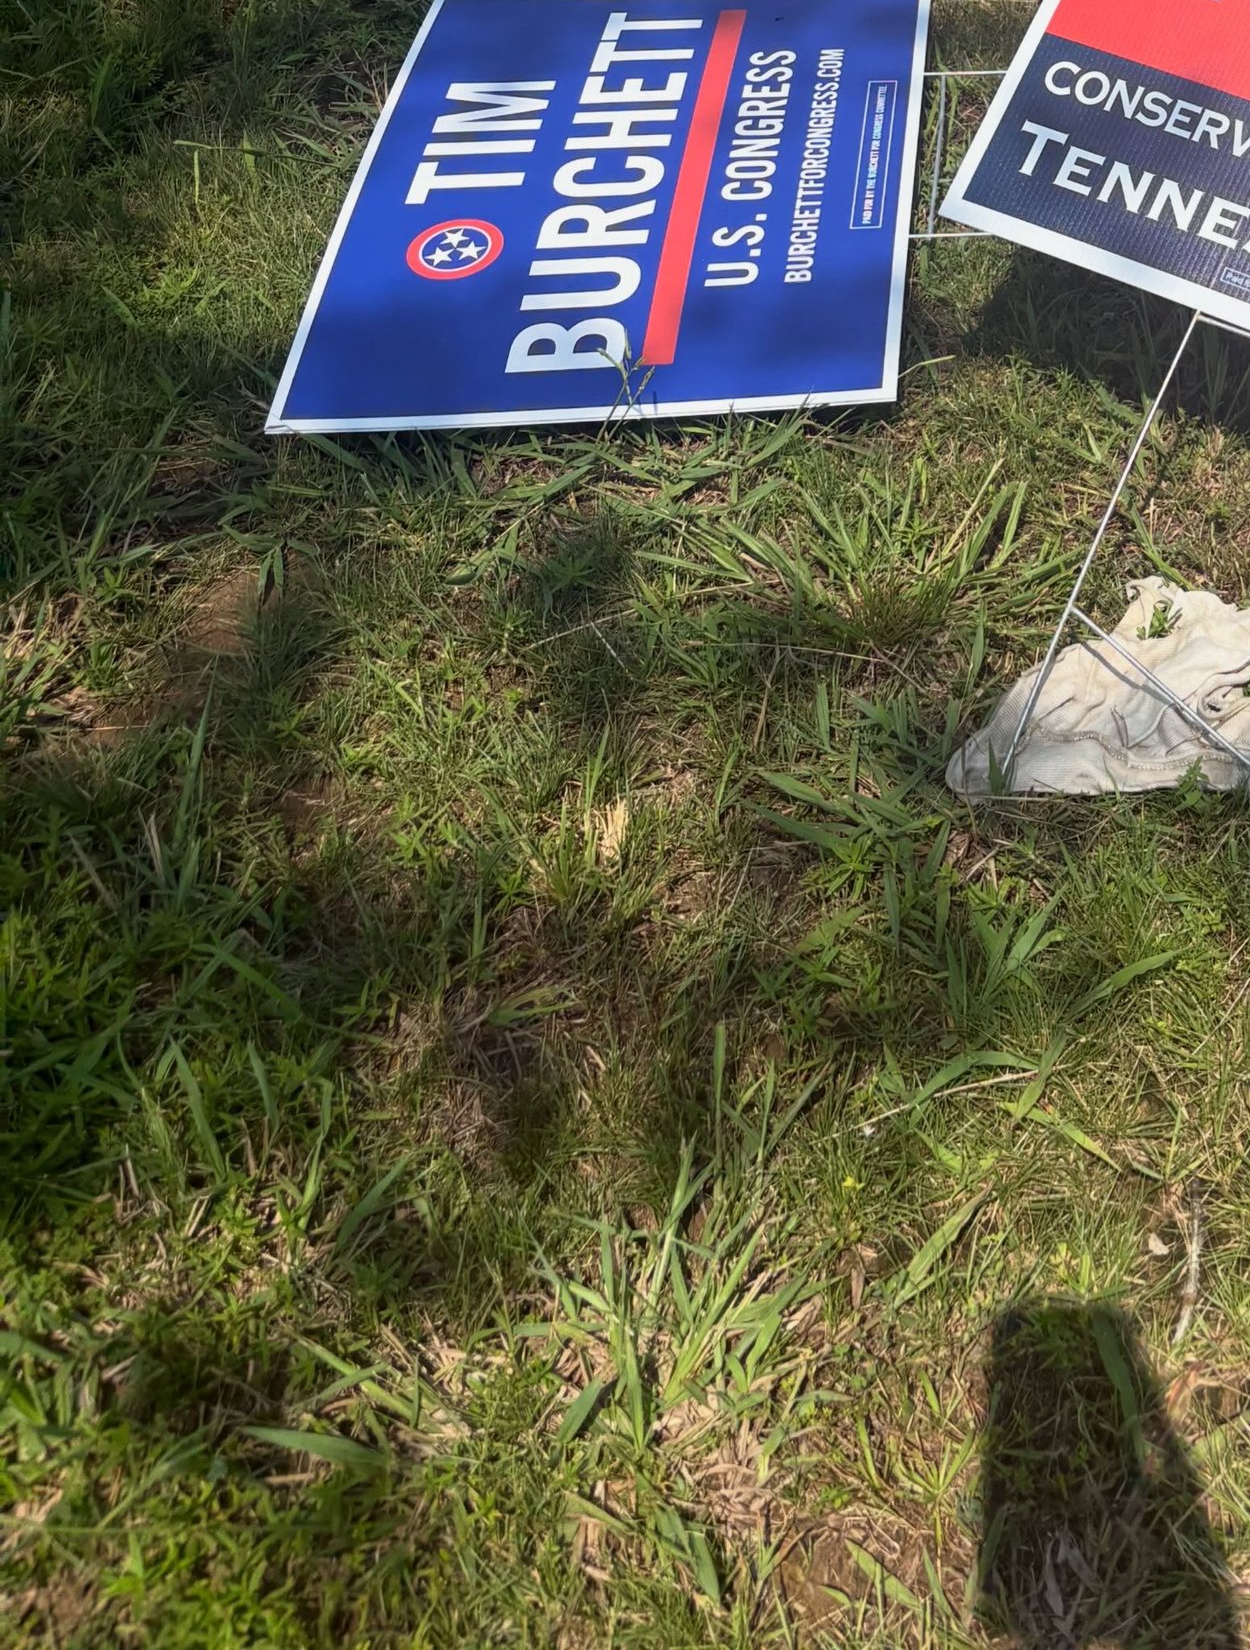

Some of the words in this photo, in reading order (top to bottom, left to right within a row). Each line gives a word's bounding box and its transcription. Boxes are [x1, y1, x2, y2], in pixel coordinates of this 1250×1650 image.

[720, 49, 797, 202] CONGRESS
[872, 113, 884, 139] CONGRESS
[405, 80, 557, 206] TIM
[870, 140, 881, 150] FOR
[784, 47, 846, 284] BURCHETTFORCONGRESS.COM
[867, 150, 880, 178] BURCHETT
[504, 12, 705, 374] BURCHETT
[865, 190, 875, 199] BY
[866, 178, 877, 189] THE
[863, 198, 874, 210] FOR
[861, 211, 873, 225] PAID
[704, 212, 767, 288] U.S.
